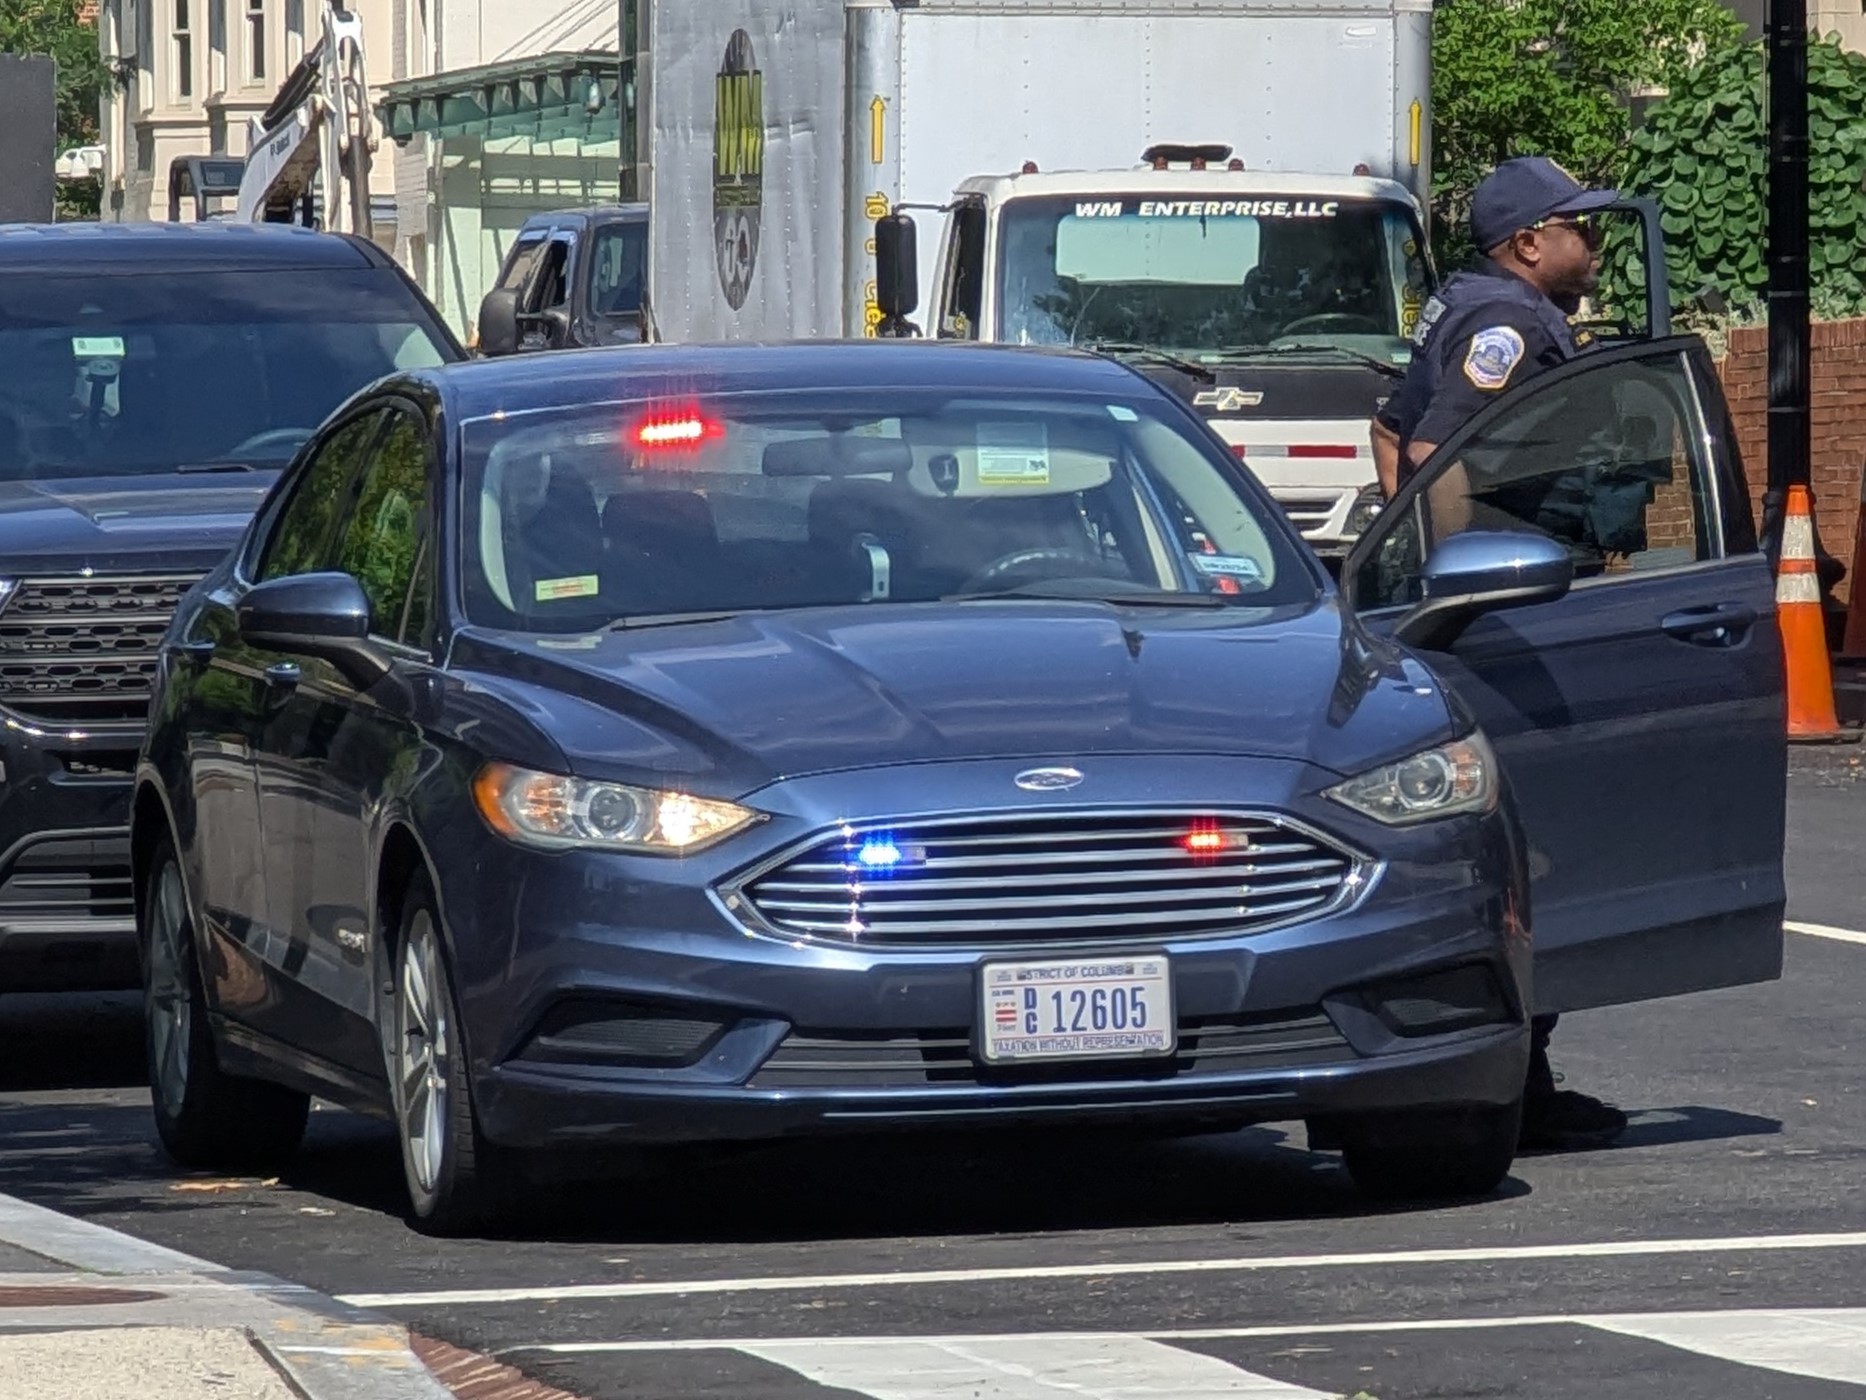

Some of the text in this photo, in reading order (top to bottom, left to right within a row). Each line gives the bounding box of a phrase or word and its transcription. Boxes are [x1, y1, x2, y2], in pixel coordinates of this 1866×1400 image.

[1075, 201, 1339, 218] WM ENTERPRISE,LLC
[1064, 966, 1079, 978] OF
[1051, 986, 1148, 1033] 12605
